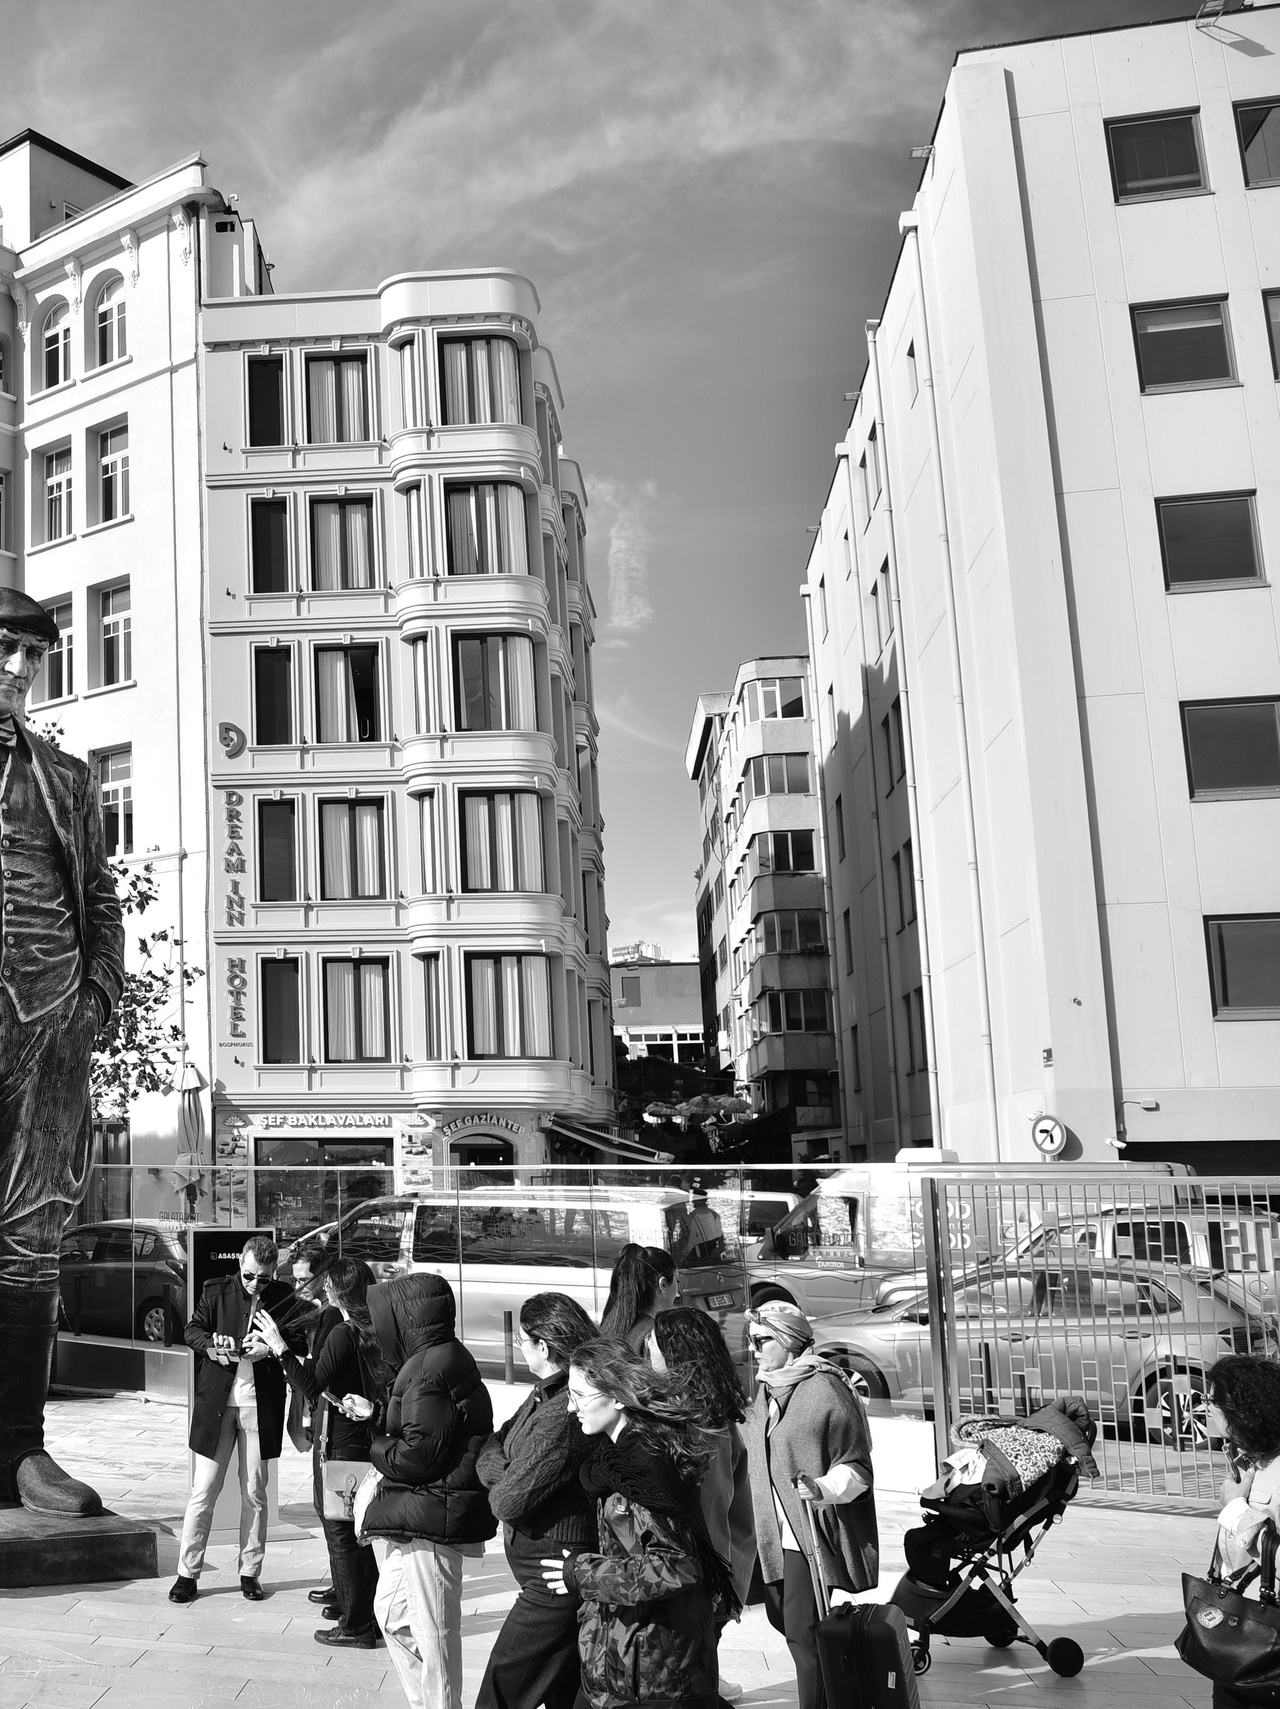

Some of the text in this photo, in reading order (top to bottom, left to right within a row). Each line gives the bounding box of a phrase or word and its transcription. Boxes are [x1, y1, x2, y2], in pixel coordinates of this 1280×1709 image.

[224, 790, 247, 928] DREAM INN
[226, 957, 248, 1039] HOTEL
[260, 1114, 390, 1129] ŞEF BAKLAVALARI
[443, 1112, 526, 1137] ŞEF GAZİANTEP
[817, 1261, 845, 1269] puratos
